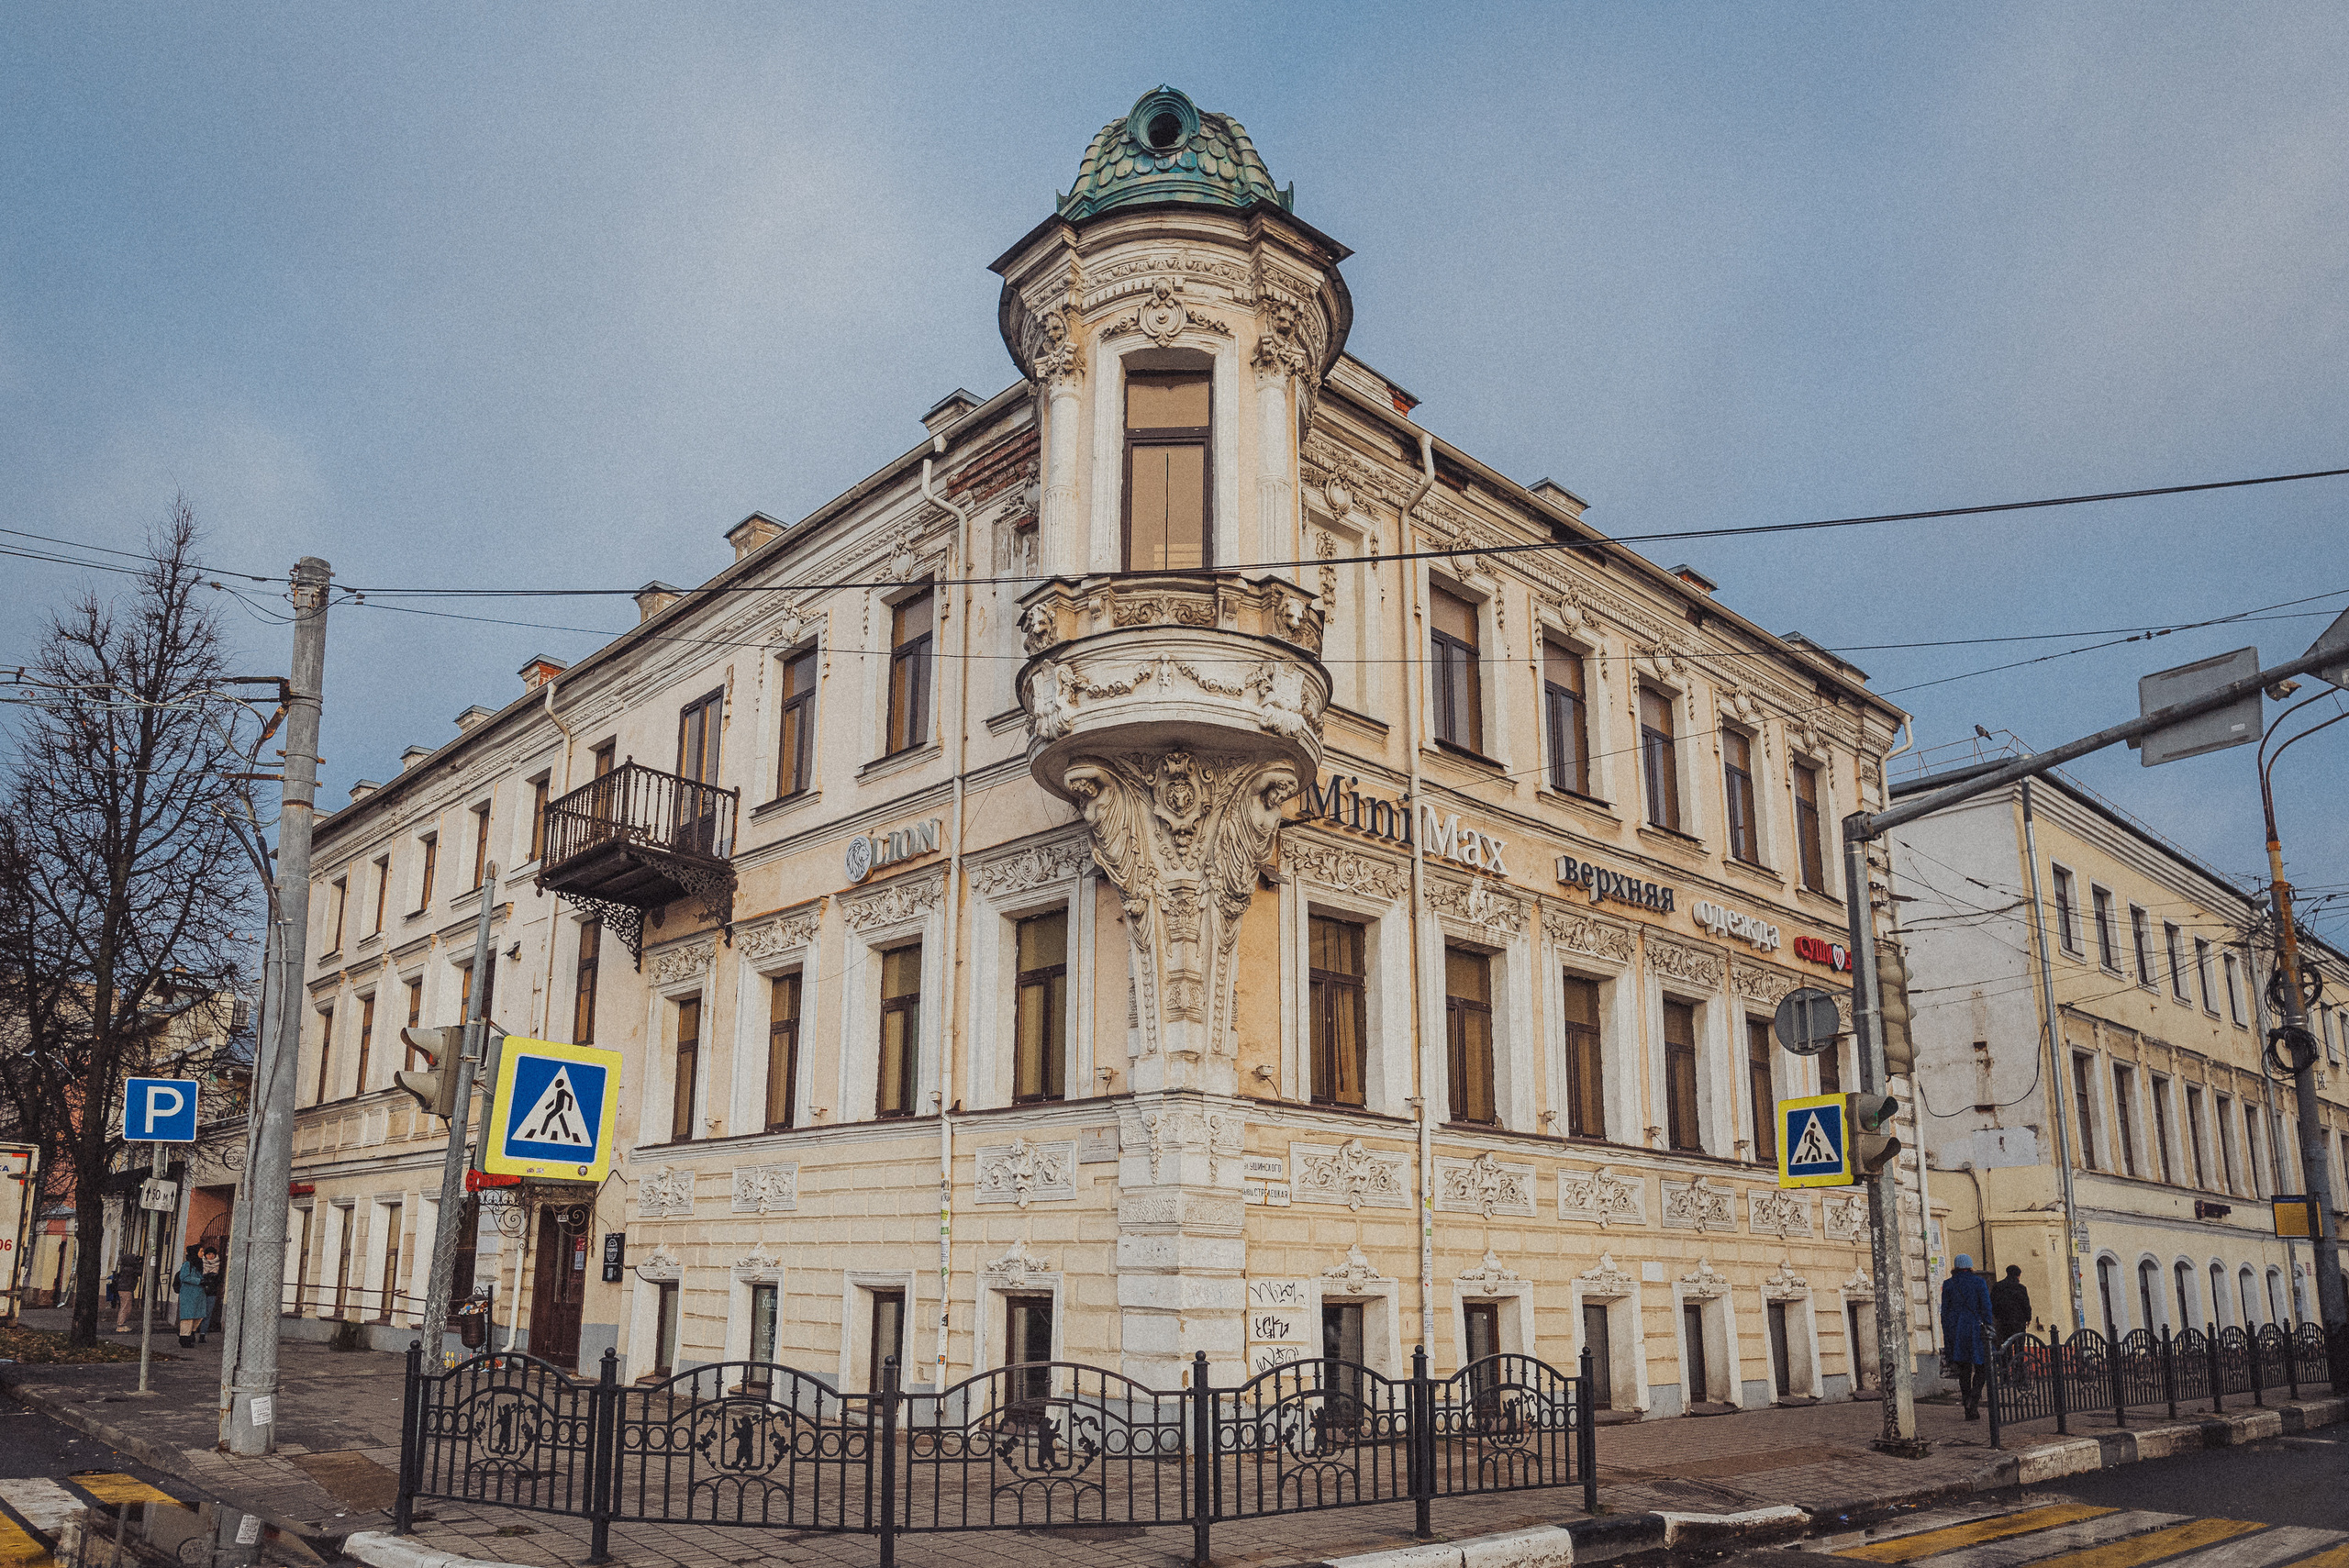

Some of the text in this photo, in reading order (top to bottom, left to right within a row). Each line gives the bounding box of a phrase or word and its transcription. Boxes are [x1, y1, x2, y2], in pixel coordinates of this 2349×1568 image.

[870, 818, 941, 867] LION
[1299, 774, 1509, 876] Mini Max
[1558, 855, 1781, 952] верхняя одежда
[145, 1085, 184, 1133] P
[1250, 1162, 1282, 1173] УШИНСКОГО
[151, 1189, 161, 1201] 50
[1254, 1187, 1288, 1199] СТРЕЛЕЦКАЯ
